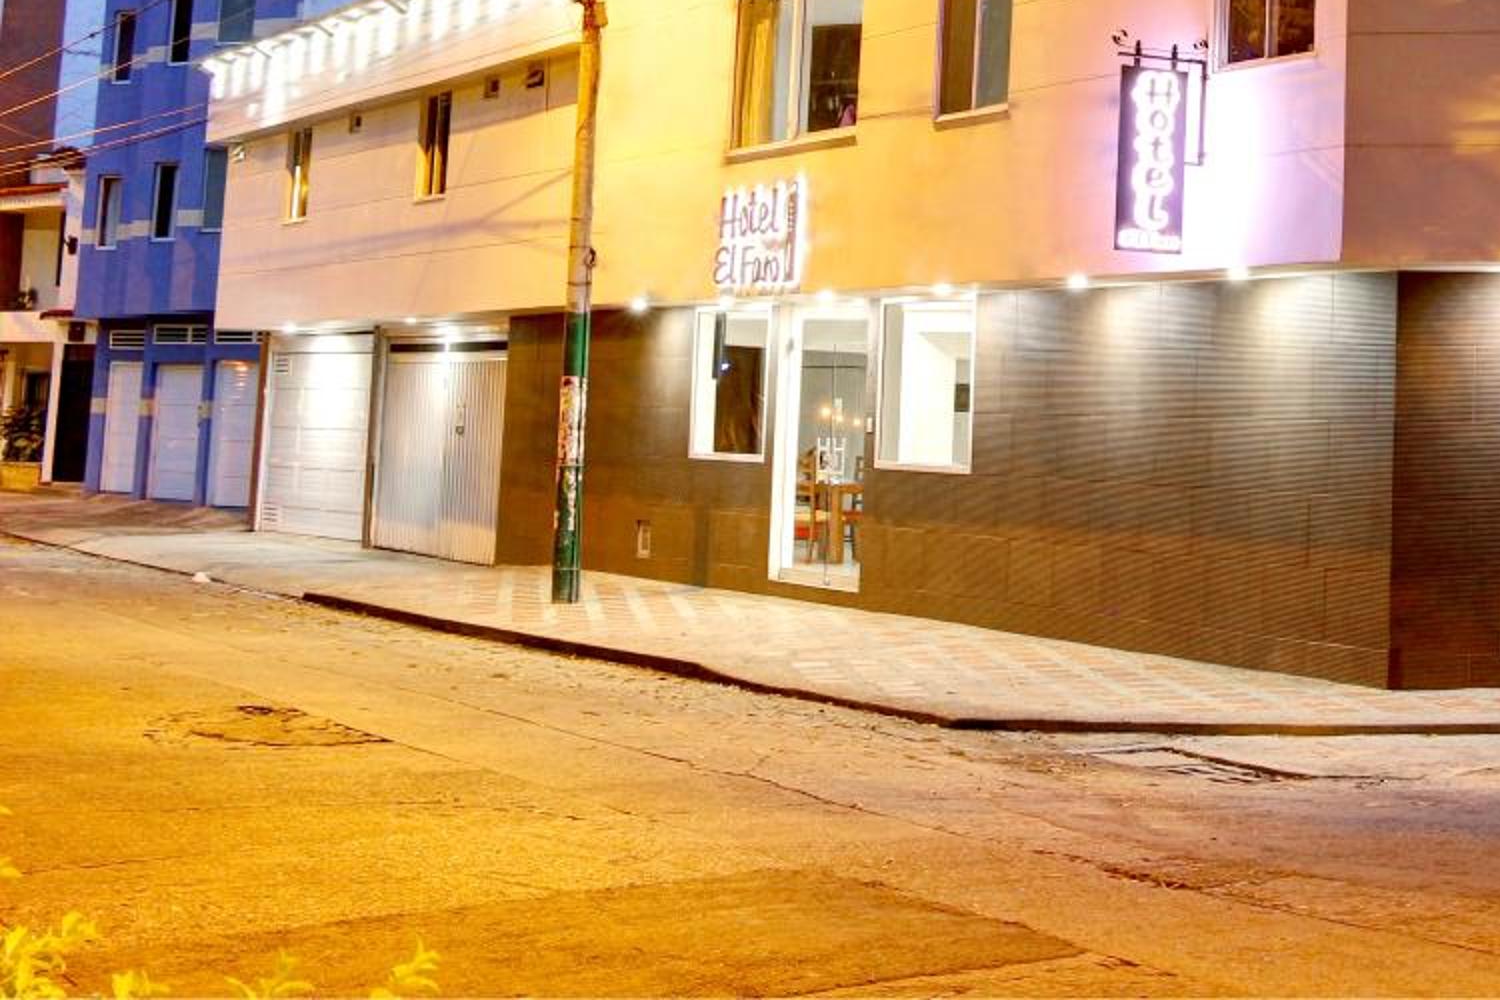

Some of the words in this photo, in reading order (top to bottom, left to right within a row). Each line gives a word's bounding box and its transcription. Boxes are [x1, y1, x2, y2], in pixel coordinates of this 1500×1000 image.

[1142, 75, 1176, 224] Hotel
[718, 187, 780, 239] Hotel
[712, 244, 737, 285] El
[740, 245, 781, 285] Faro
